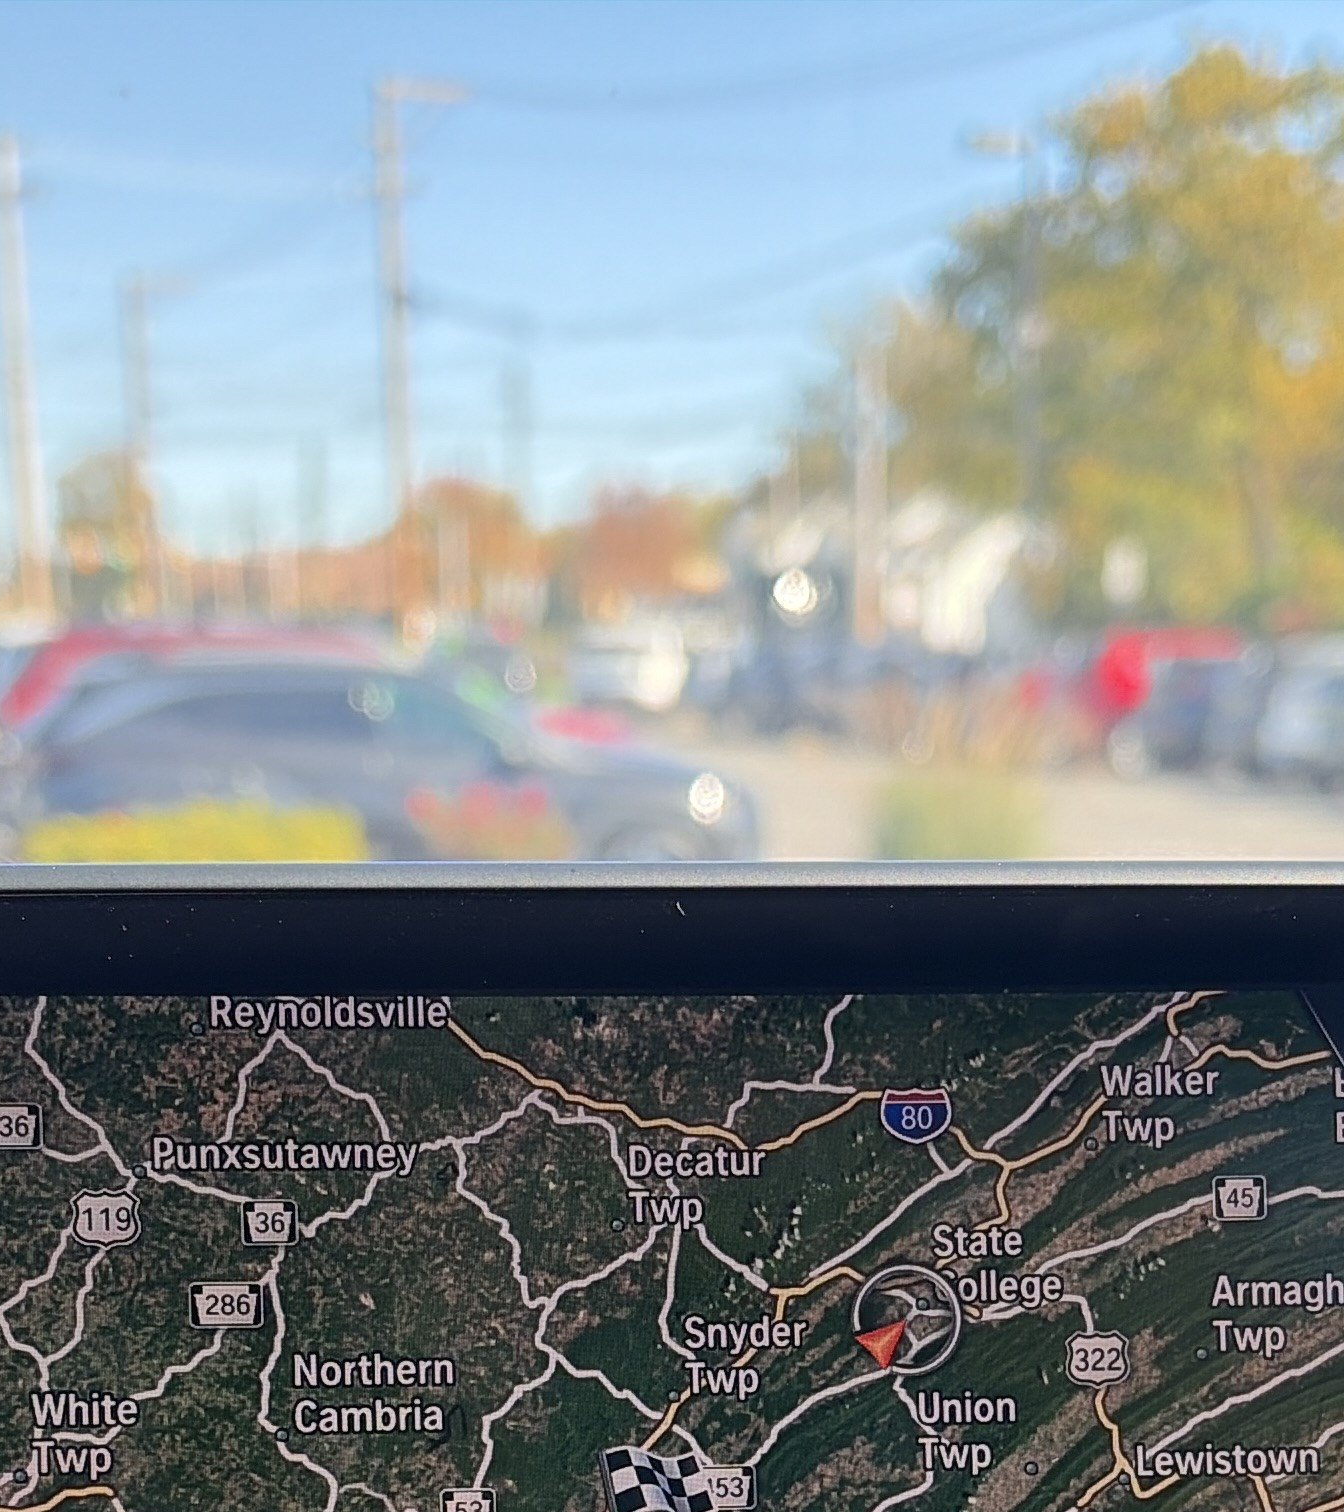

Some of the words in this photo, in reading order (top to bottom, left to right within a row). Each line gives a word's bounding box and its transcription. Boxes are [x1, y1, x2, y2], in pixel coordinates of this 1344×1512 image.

[210, 996, 450, 1034] Reynoldsville
[1101, 1065, 1219, 1096] Walker
[902, 1106, 932, 1128] 80
[1103, 1110, 1174, 1146] Twp
[152, 1138, 419, 1176] Punxsutawney
[627, 1146, 765, 1177] Decatur
[629, 1192, 703, 1227] Twp
[1226, 1188, 1253, 1209] 45
[81, 1207, 131, 1232] 119
[256, 1212, 285, 1233] 36
[933, 1224, 1023, 1257] State
[205, 1295, 251, 1315] 286
[1212, 1274, 1344, 1310] Armagh
[685, 1318, 807, 1353] Snyder
[1212, 1321, 1286, 1355] Twp
[293, 1355, 454, 1386] Northern
[1075, 1348, 1122, 1371] 322
[685, 1362, 759, 1397] Twp
[32, 1394, 138, 1425] White
[294, 1402, 444, 1433] Cambria
[917, 1393, 1016, 1424] Union
[34, 1442, 112, 1479] Twp
[918, 1438, 992, 1474] Twp
[1136, 1445, 1318, 1475] Lewistown
